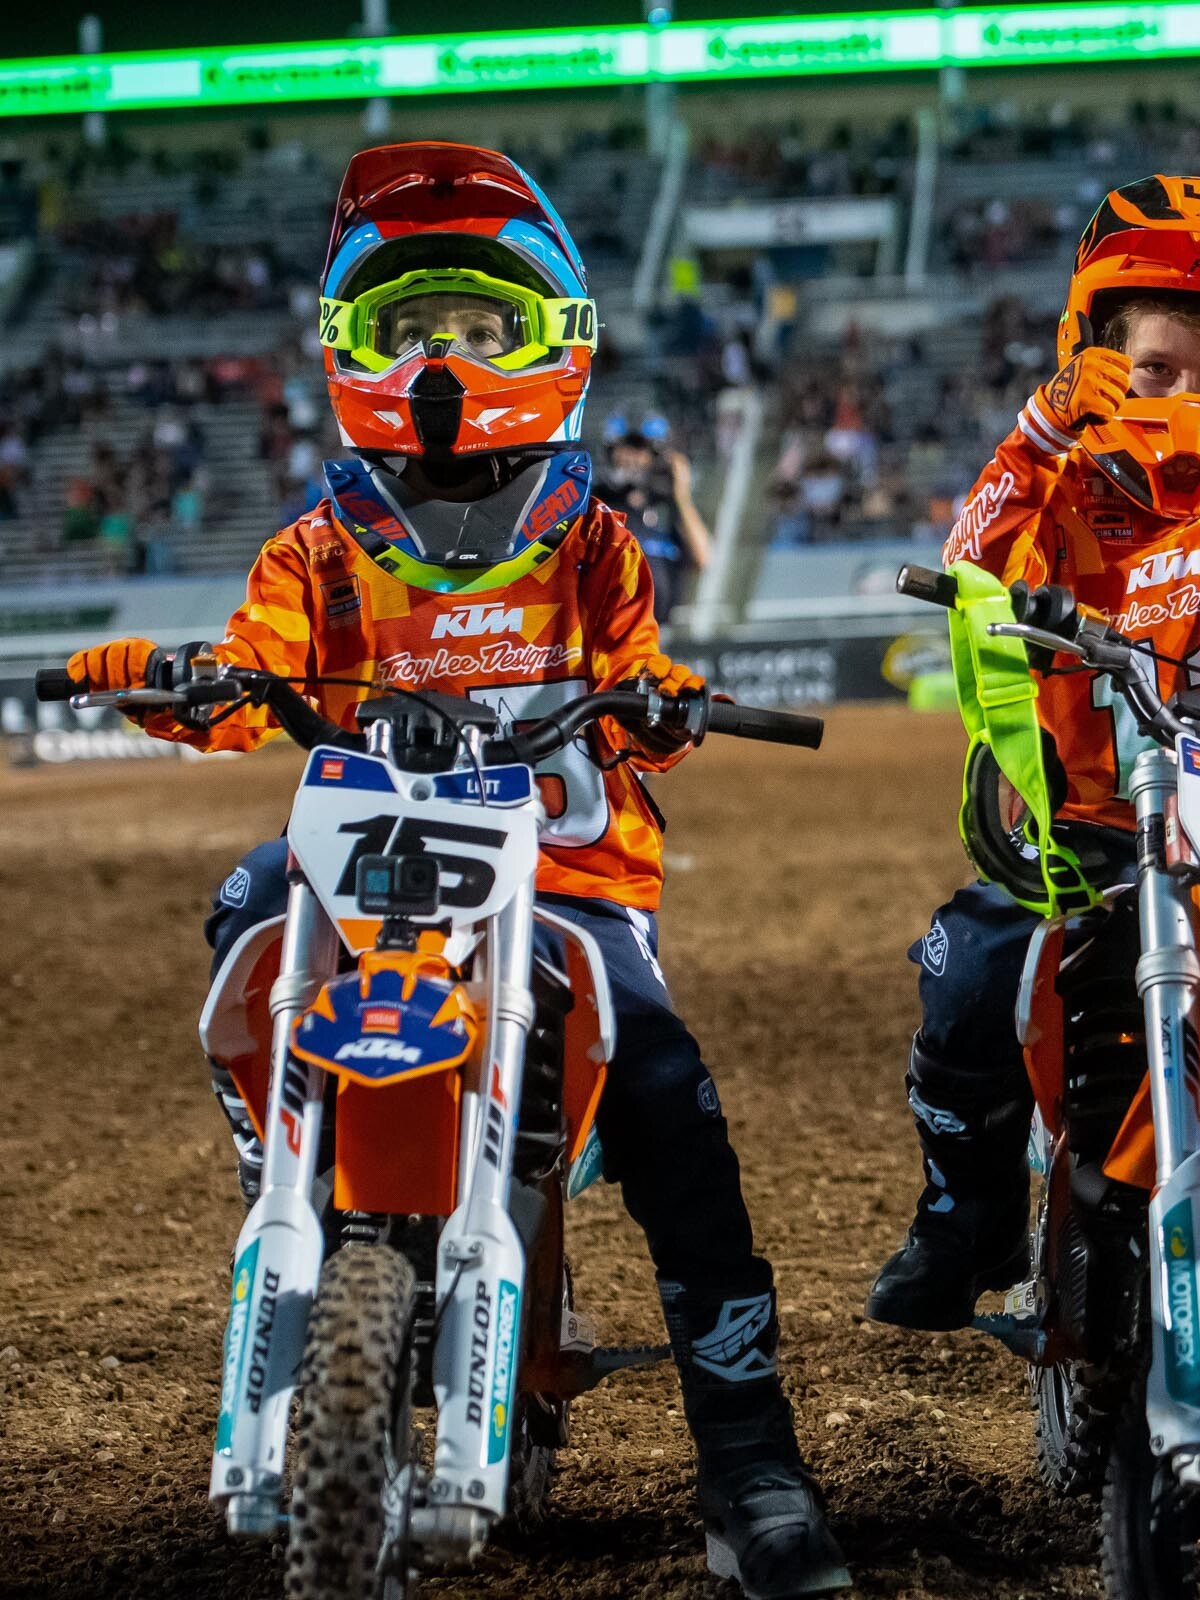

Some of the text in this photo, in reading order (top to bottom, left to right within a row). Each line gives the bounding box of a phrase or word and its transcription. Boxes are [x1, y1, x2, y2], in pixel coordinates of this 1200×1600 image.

[458, 441, 489, 451] KINETIC
[378, 641, 583, 684] Troy Lee Designs
[430, 602, 524, 639] KTM
[1125, 601, 1169, 631] Lee
[334, 814, 508, 909] 15
[334, 1037, 423, 1064] KTM
[221, 1303, 248, 1414] MOTOREX
[246, 1266, 281, 1416] DUNLOP
[466, 1280, 493, 1430] DUNLOP
[493, 1290, 518, 1401] MOTOREX
[1170, 1259, 1196, 1369] MOTOREX
